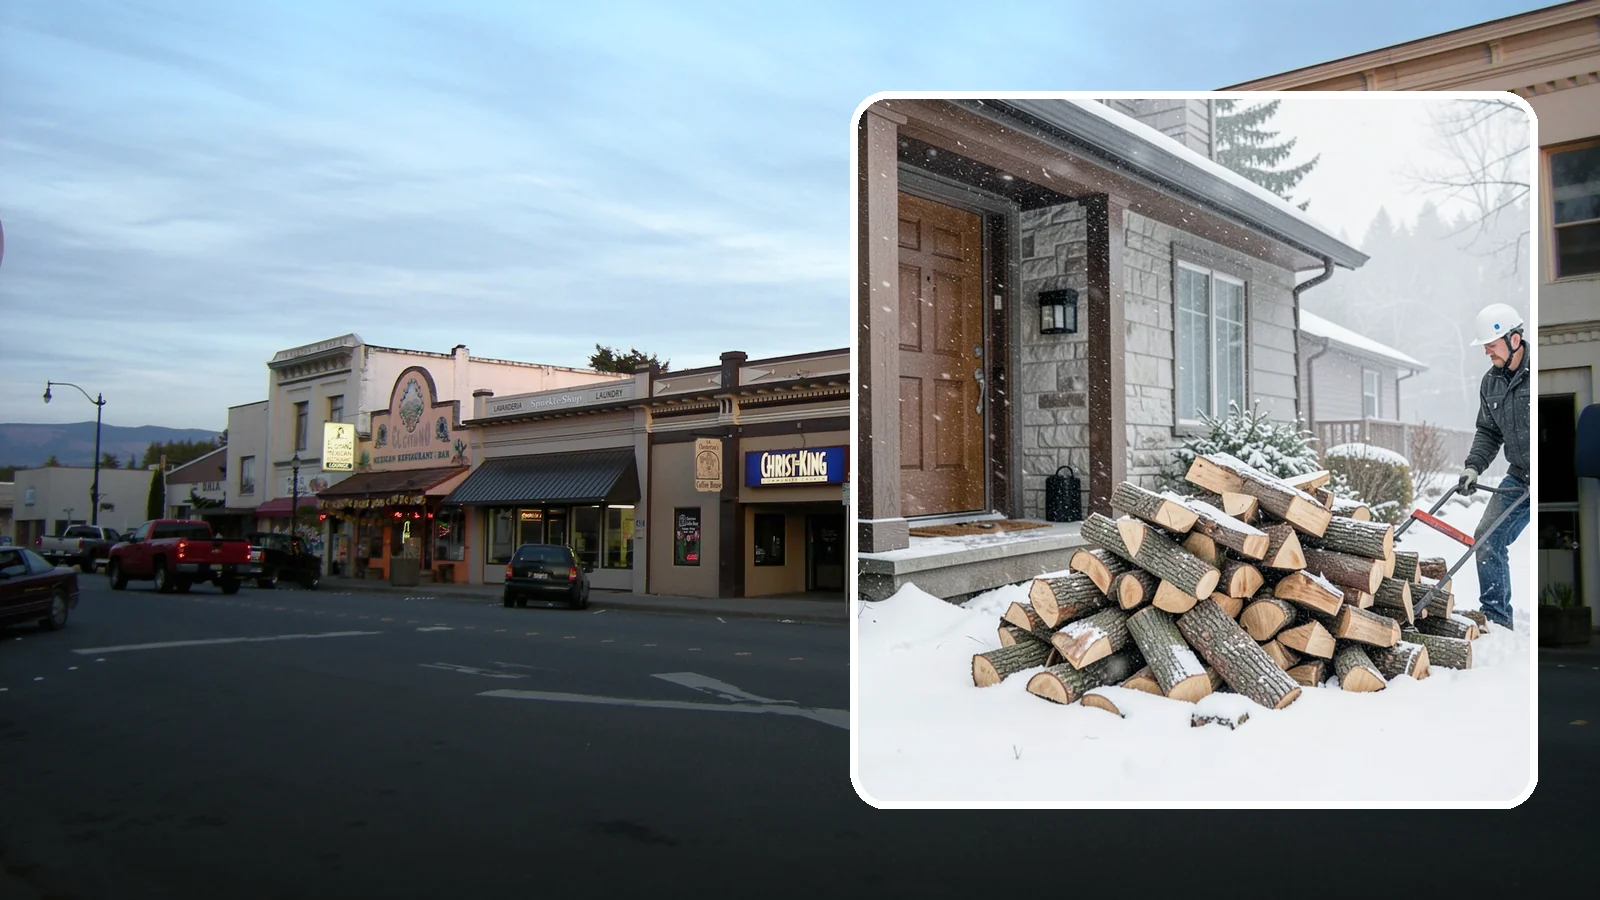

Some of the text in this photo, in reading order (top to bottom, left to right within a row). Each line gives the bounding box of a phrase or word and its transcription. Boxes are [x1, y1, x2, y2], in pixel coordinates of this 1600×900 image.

[493, 401, 523, 413] LAVANDERIA
[561, 394, 582, 405] Shop
[595, 388, 624, 400] LAUNDRY
[373, 450, 450, 464] MEXICAN RESTAURANT BAR
[760, 450, 828, 478] CHRIST KING
[696, 480, 709, 489] Coffee
